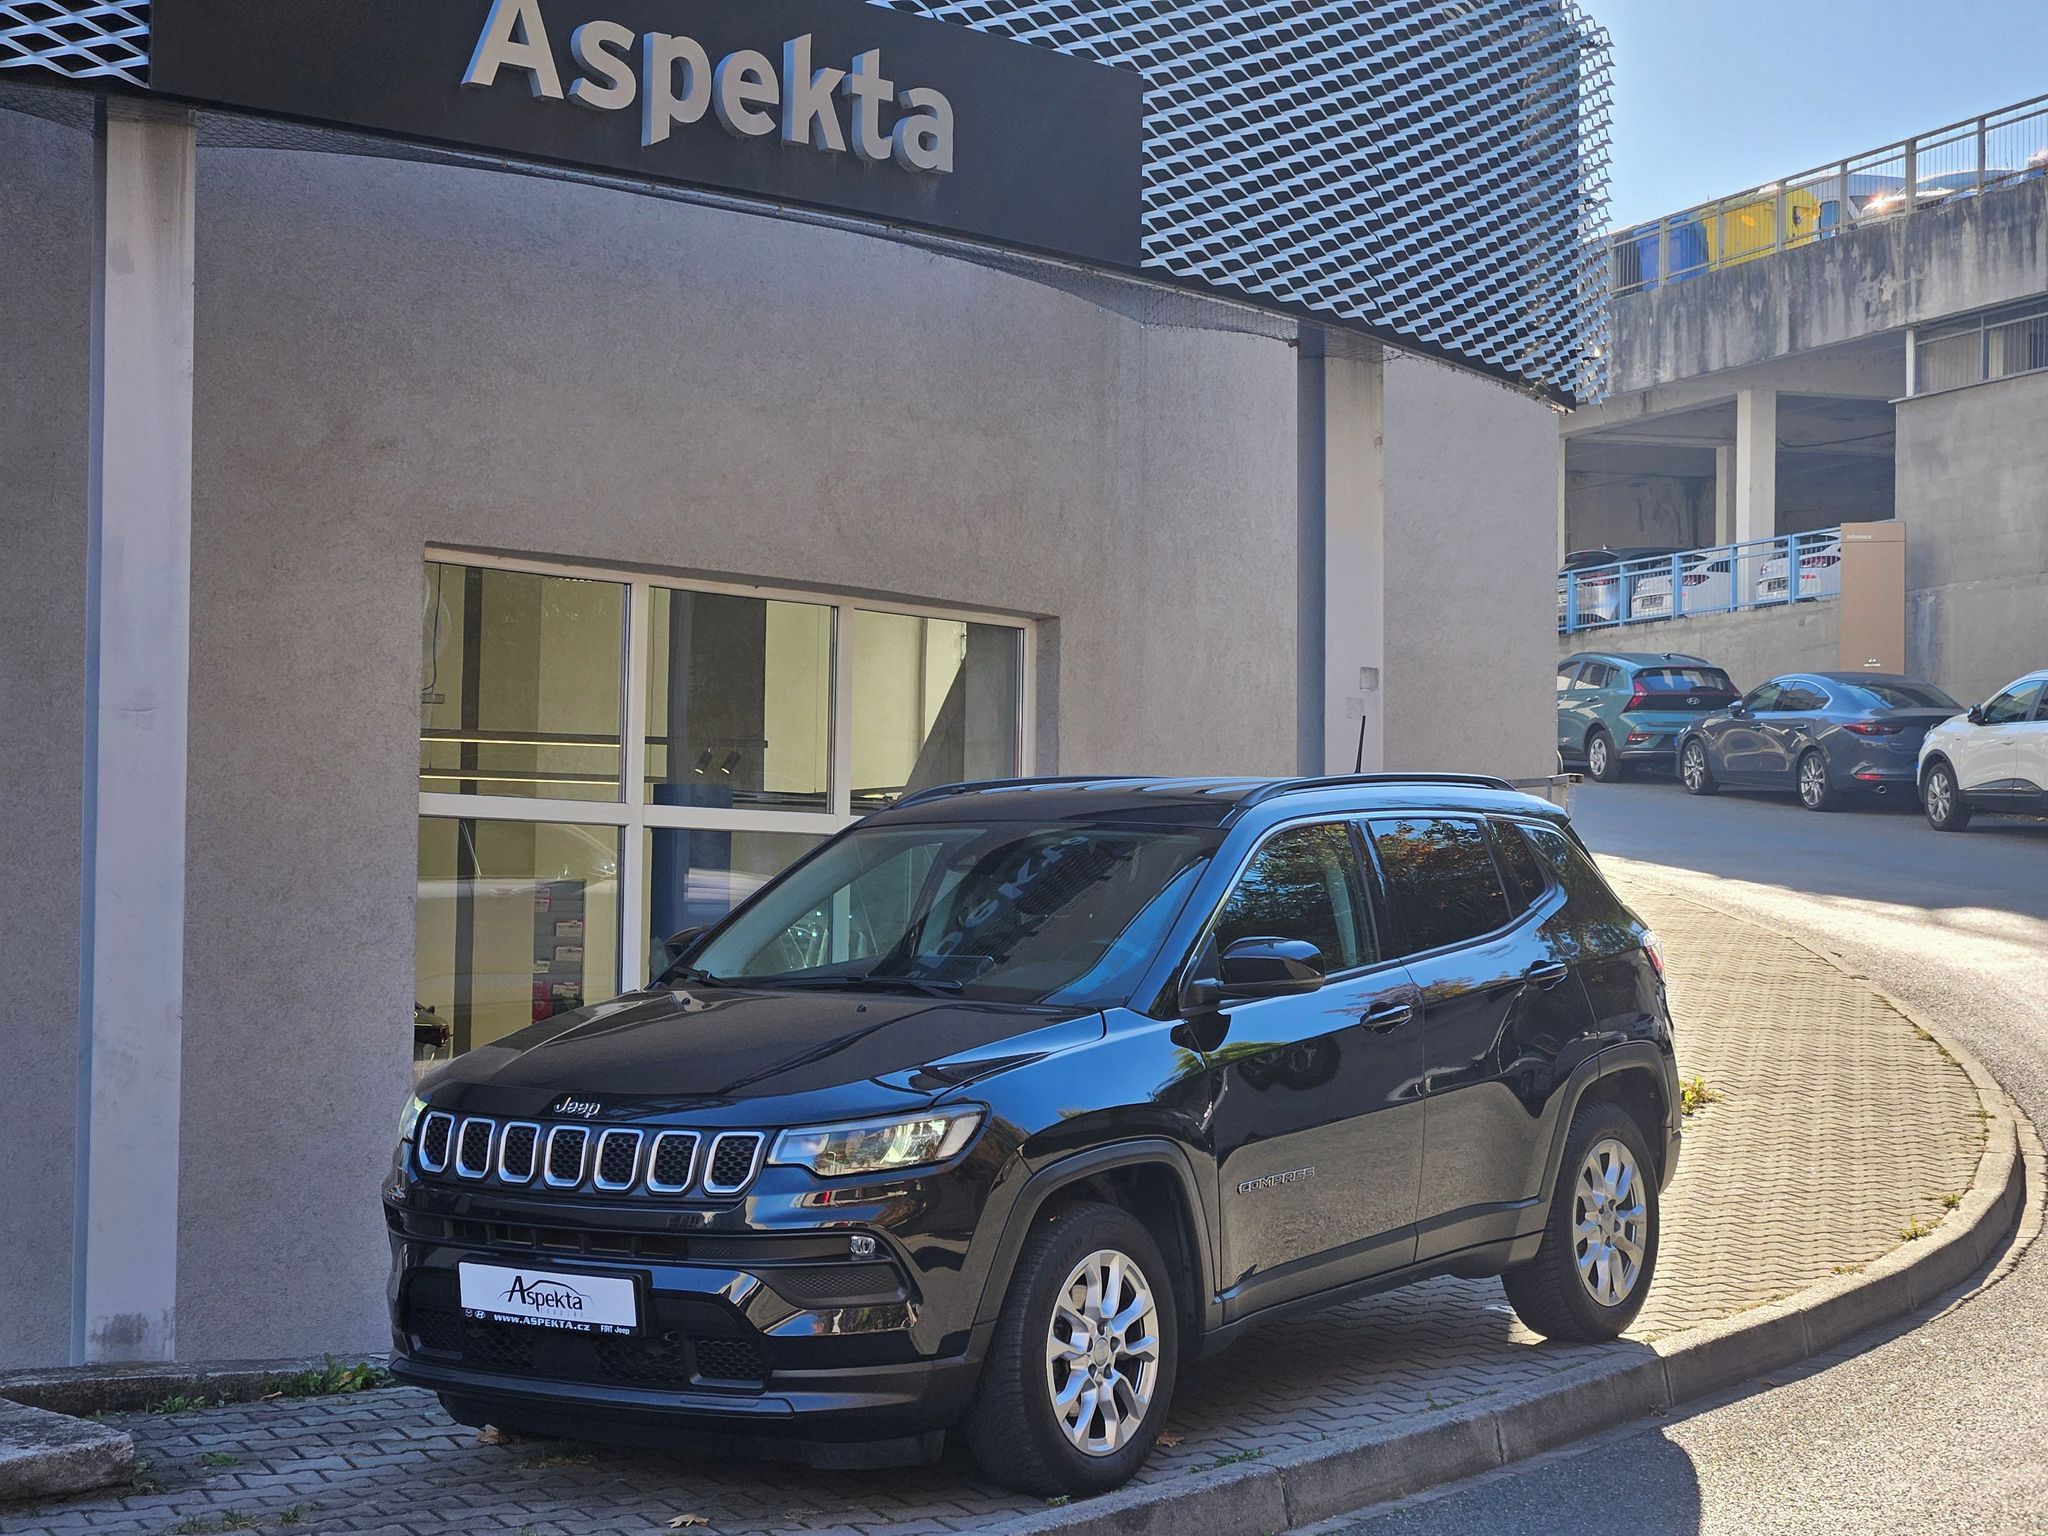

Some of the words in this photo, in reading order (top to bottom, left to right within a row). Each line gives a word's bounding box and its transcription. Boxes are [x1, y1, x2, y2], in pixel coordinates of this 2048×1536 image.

[461, 0, 954, 174] Aspekta
[554, 1097, 600, 1118] Jeep
[1238, 1167, 1315, 1194] COMPASS
[507, 1275, 583, 1313] Aspekta
[600, 1324, 613, 1334] FIAT
[614, 1326, 630, 1336] Jeep
